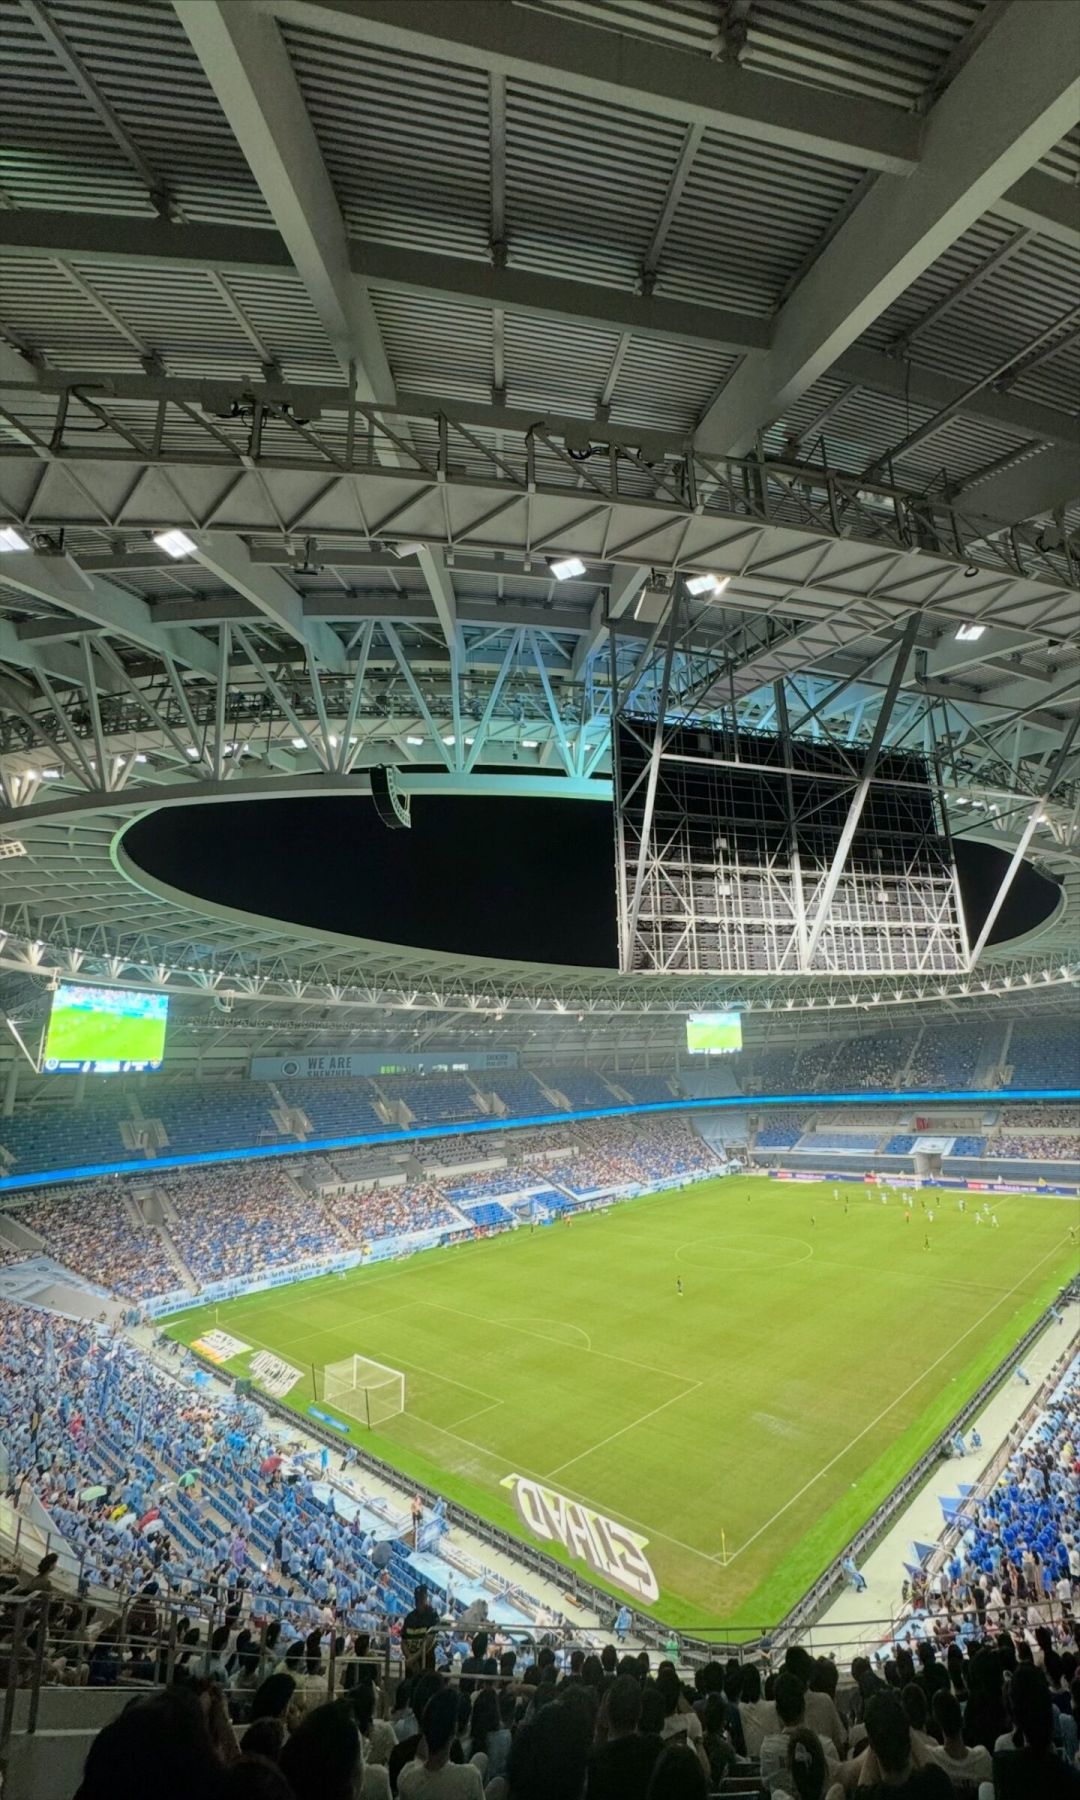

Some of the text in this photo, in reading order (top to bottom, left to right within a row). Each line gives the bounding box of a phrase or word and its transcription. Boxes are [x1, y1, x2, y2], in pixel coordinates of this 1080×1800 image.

[308, 1056, 352, 1070] WE ARE
[514, 1478, 660, 1602] ETIHAD
